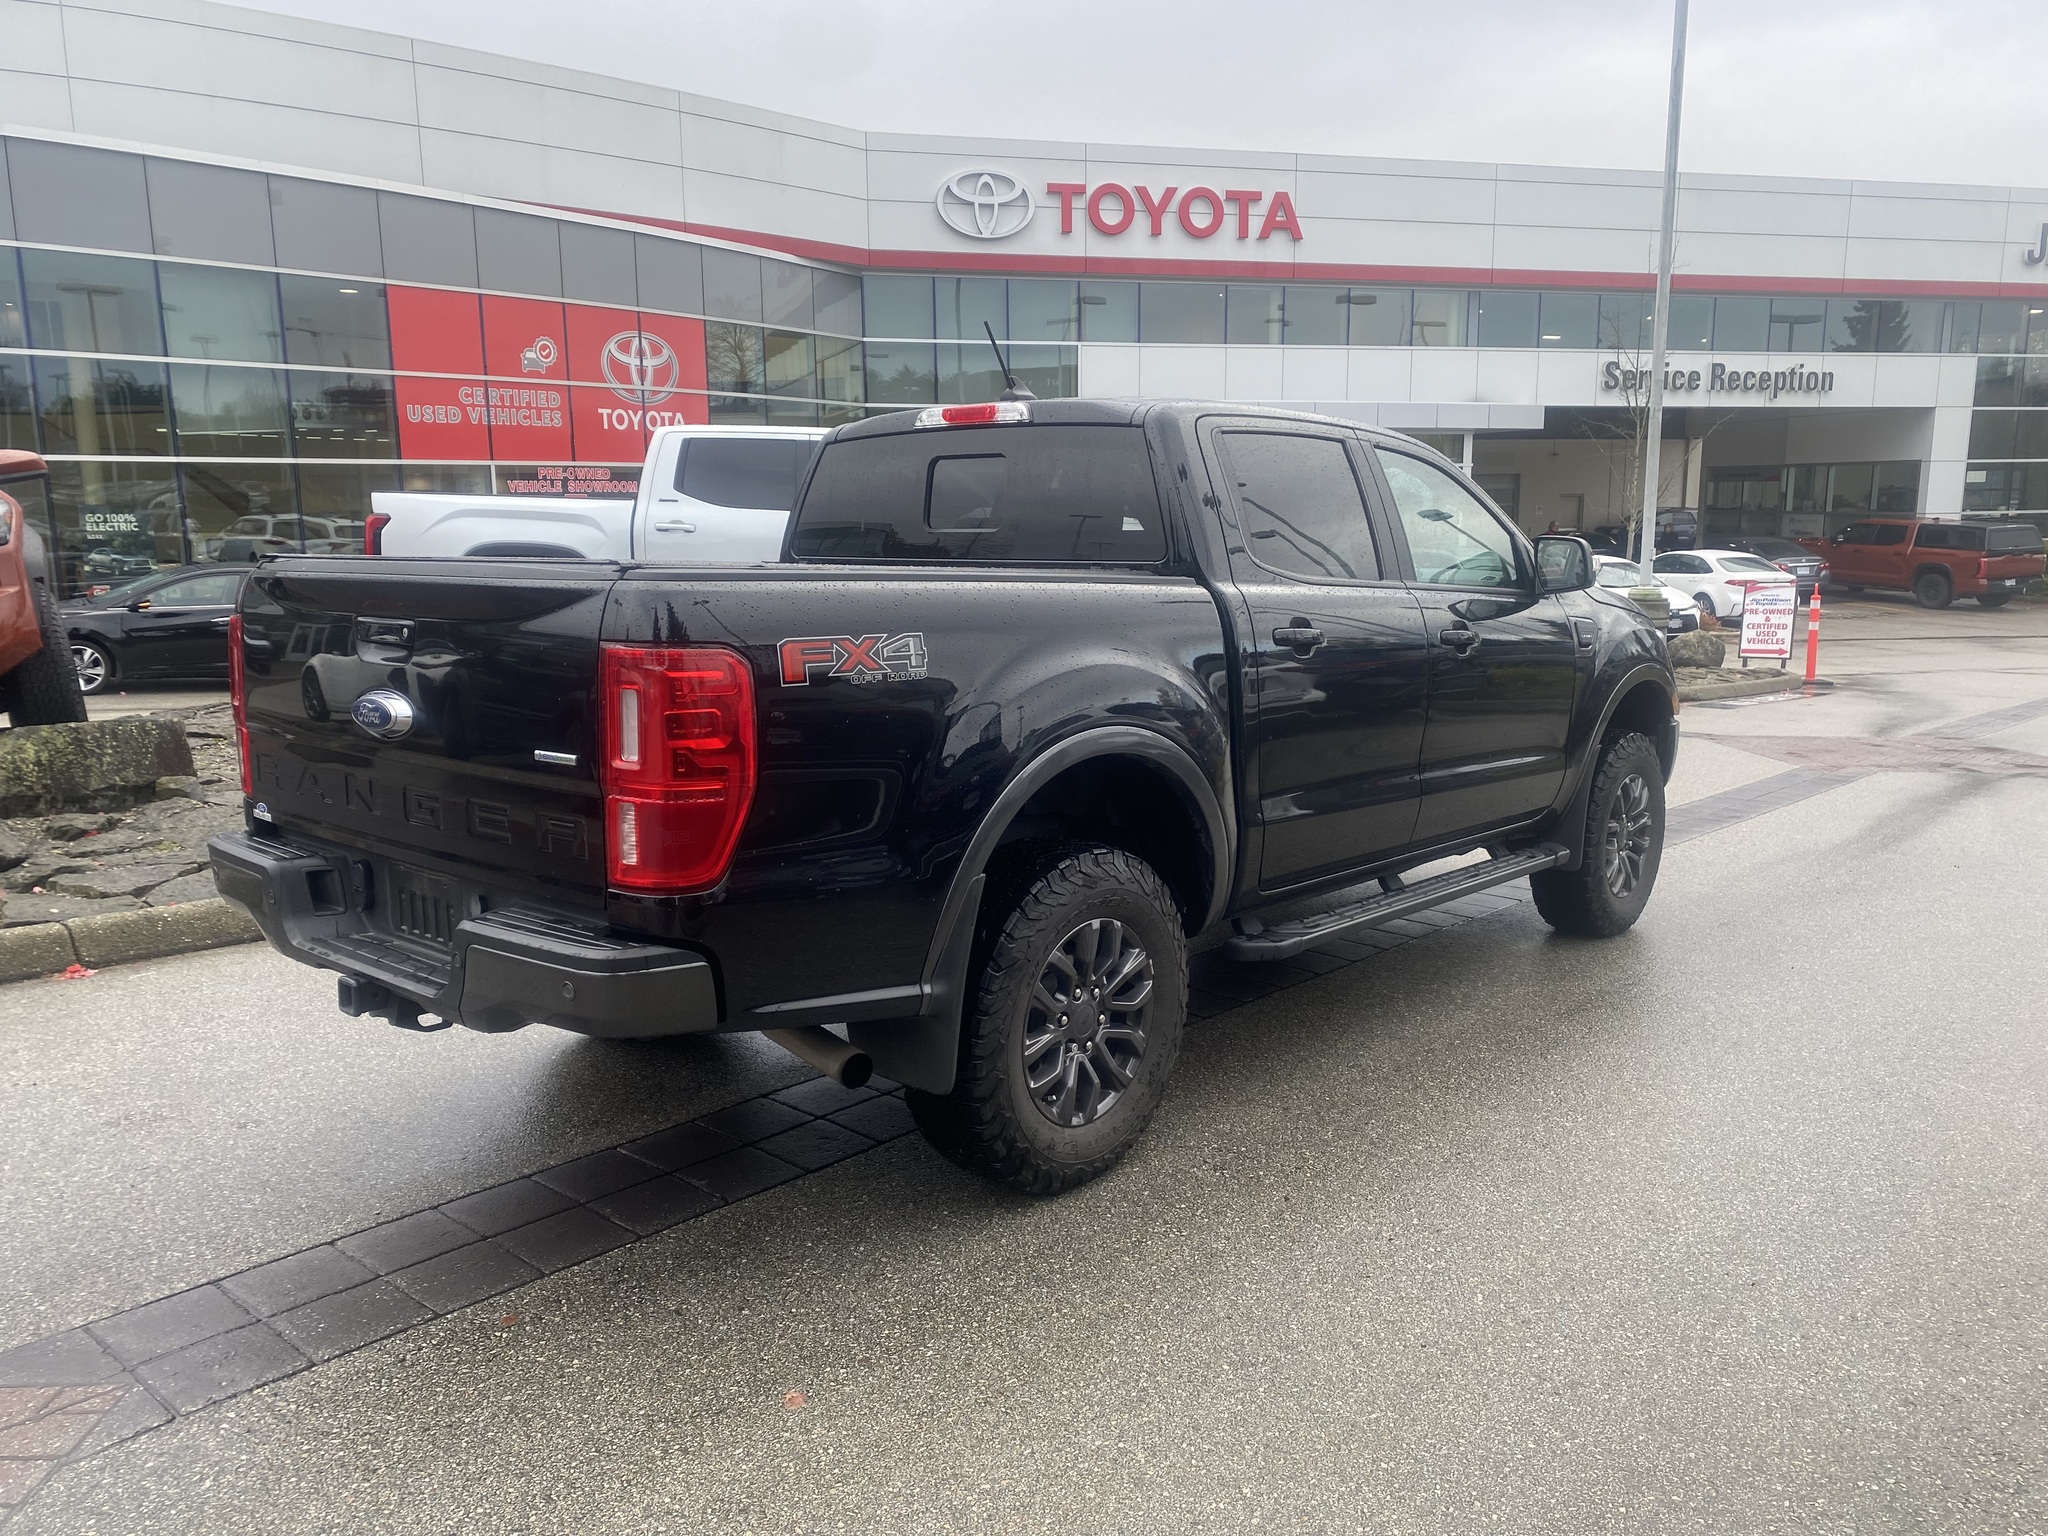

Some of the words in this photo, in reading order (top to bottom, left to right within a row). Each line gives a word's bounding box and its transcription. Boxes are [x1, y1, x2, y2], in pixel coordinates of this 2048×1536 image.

[1046, 182, 1304, 241] TOYOTA
[1602, 360, 1701, 391] Serice
[1708, 362, 1834, 400] Reception
[458, 386, 561, 408] CERTIFIED
[406, 404, 461, 423] USED
[466, 406, 562, 427] VEHICLES
[598, 408, 685, 431] TOYOTA
[537, 467, 611, 480] PRE-OWNED
[507, 480, 562, 493] VEHICLE
[567, 481, 638, 493] SHOWROOM
[85, 513, 104, 523] GO
[105, 513, 137, 523] 100%
[85, 522, 139, 532] ELECTRIC
[777, 632, 928, 687] FX4
[850, 673, 882, 685] OFF
[887, 670, 928, 682] ROAD
[357, 702, 382, 724] Ford
[256, 753, 588, 862] RANGER
